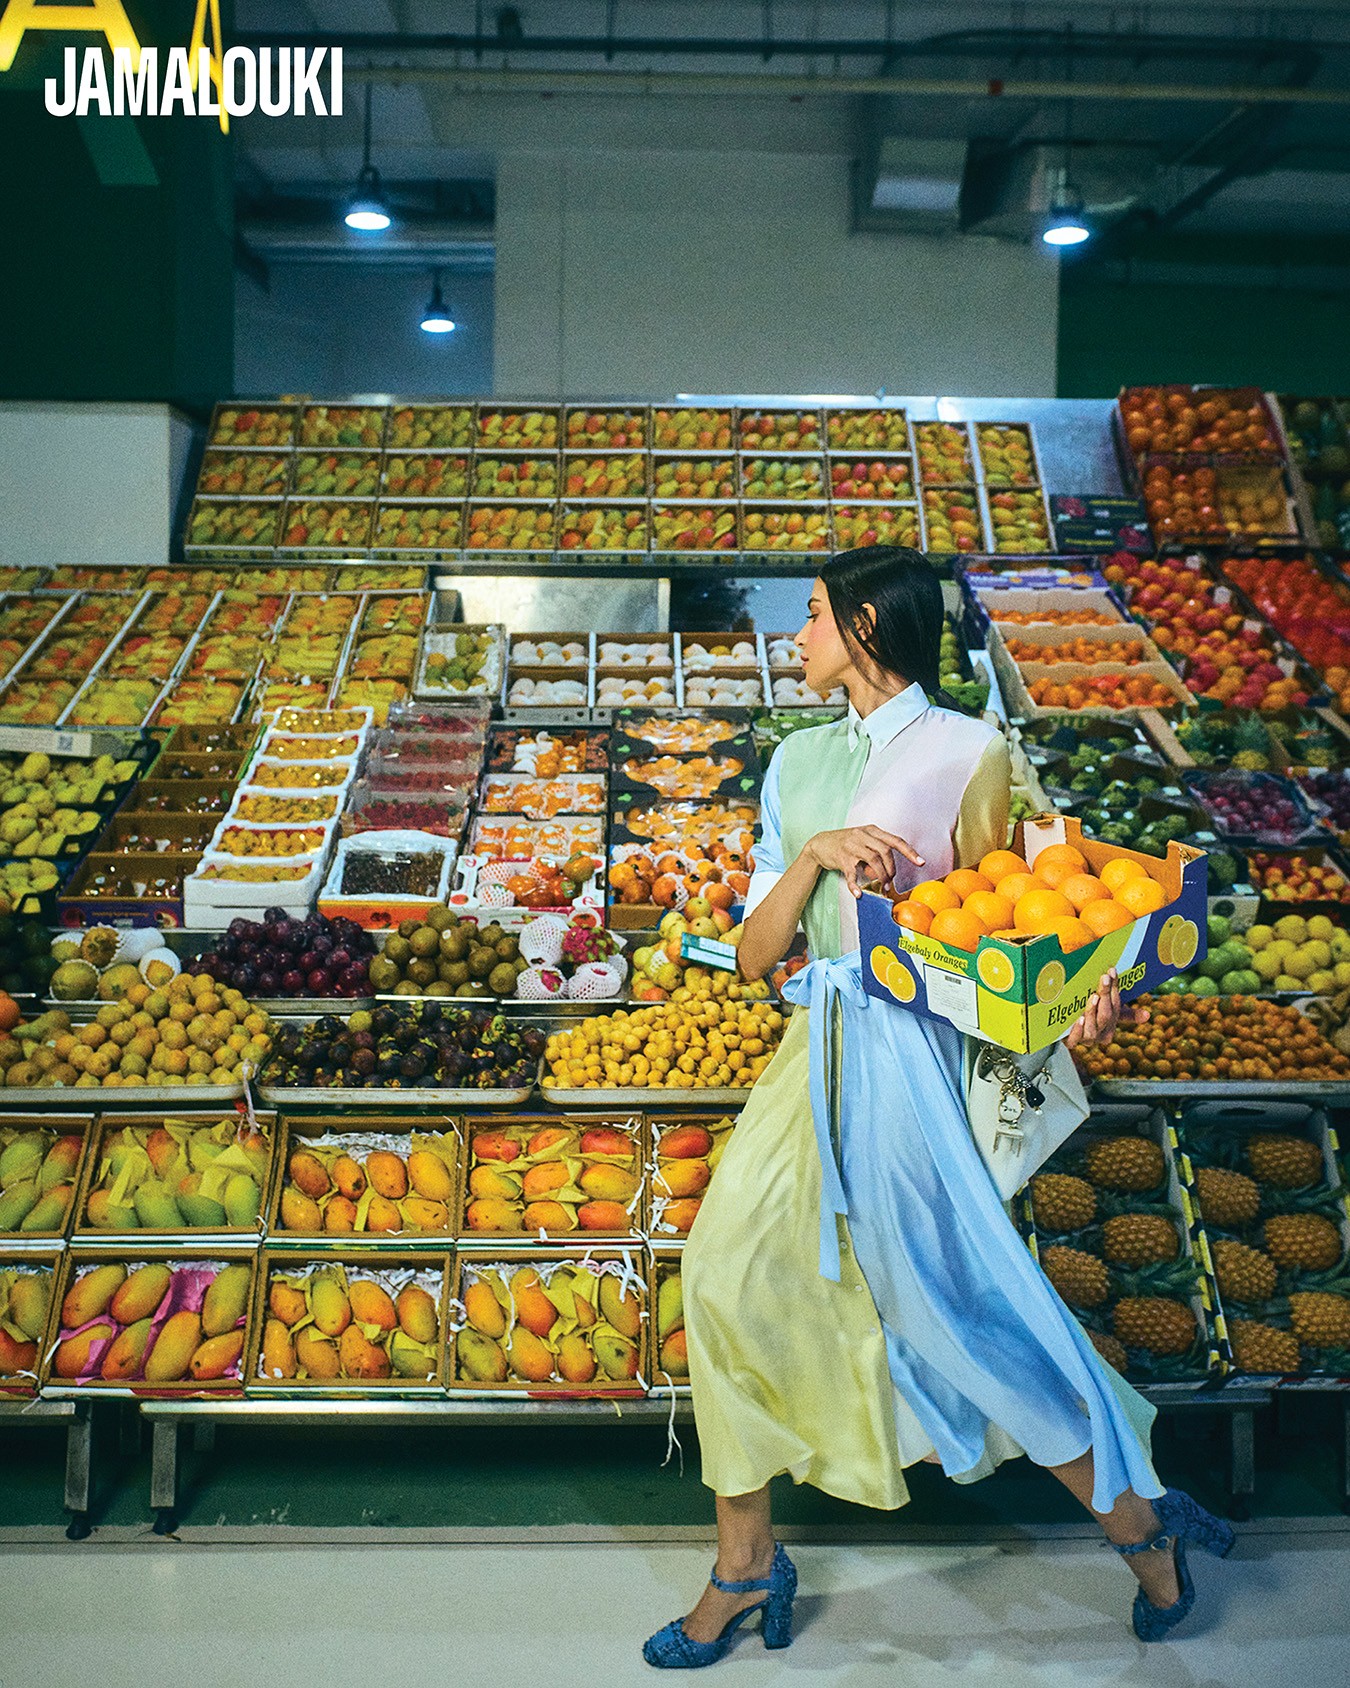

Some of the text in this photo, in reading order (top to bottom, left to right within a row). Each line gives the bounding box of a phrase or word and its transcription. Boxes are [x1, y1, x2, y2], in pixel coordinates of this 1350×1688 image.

[899, 939, 967, 969] Elgebaly Oranges
[1047, 987, 1097, 1027] Elgebal
